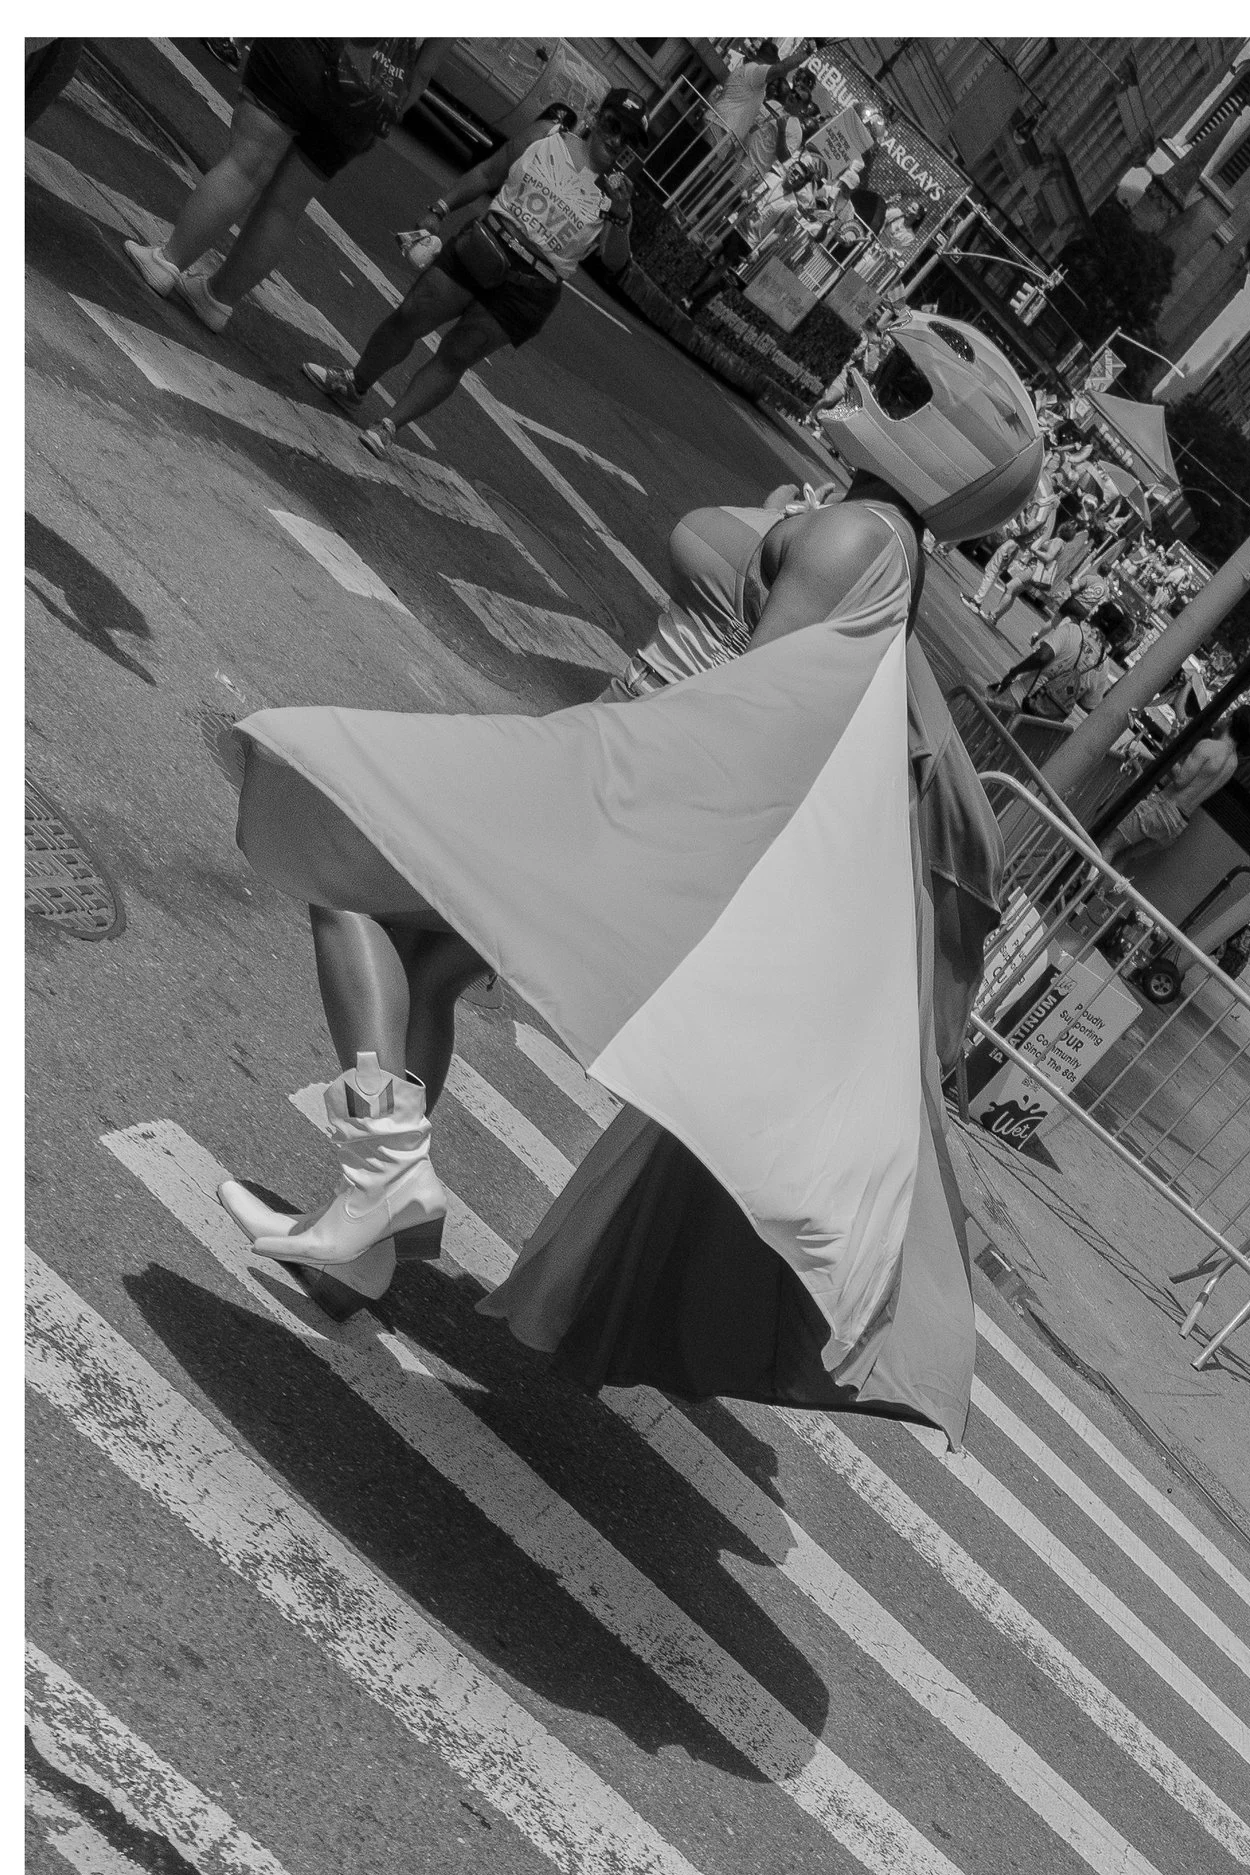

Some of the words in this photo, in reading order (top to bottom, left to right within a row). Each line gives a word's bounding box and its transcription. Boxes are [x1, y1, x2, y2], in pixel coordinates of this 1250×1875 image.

[877, 129, 947, 203] ARCLAYS
[507, 202, 563, 254] TOGETHER
[514, 182, 579, 246] LOVE
[521, 172, 585, 231] EMPOWERING
[991, 993, 1058, 1065] PATINUM
[1073, 1002, 1107, 1030] Poudly
[1045, 1058, 1062, 1073] The
[1060, 1067, 1078, 1084] 80s
[991, 1109, 1043, 1137] Wet
